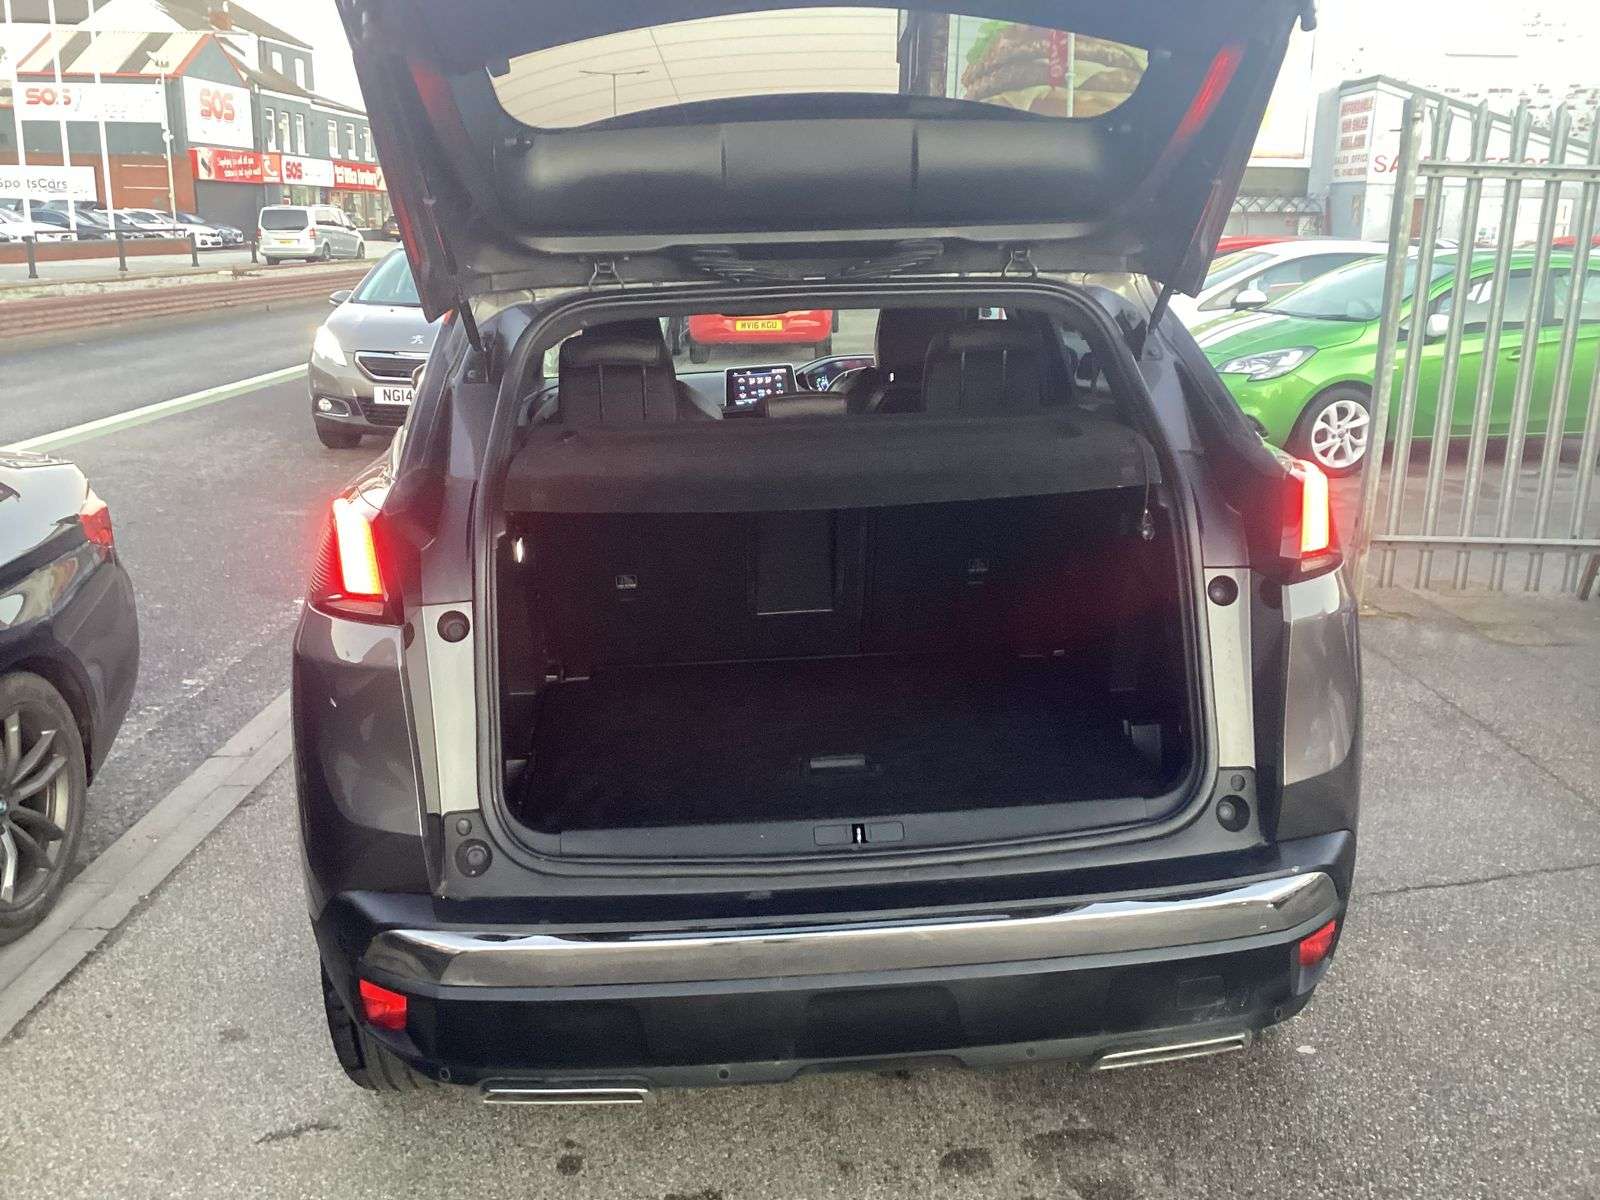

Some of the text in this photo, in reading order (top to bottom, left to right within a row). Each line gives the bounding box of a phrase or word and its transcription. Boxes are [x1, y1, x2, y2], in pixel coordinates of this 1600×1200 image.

[25, 88, 72, 106] SOS
[200, 87, 235, 121] SOS
[286, 161, 303, 181] SOS
[0, 177, 68, 191] SpotsCars
